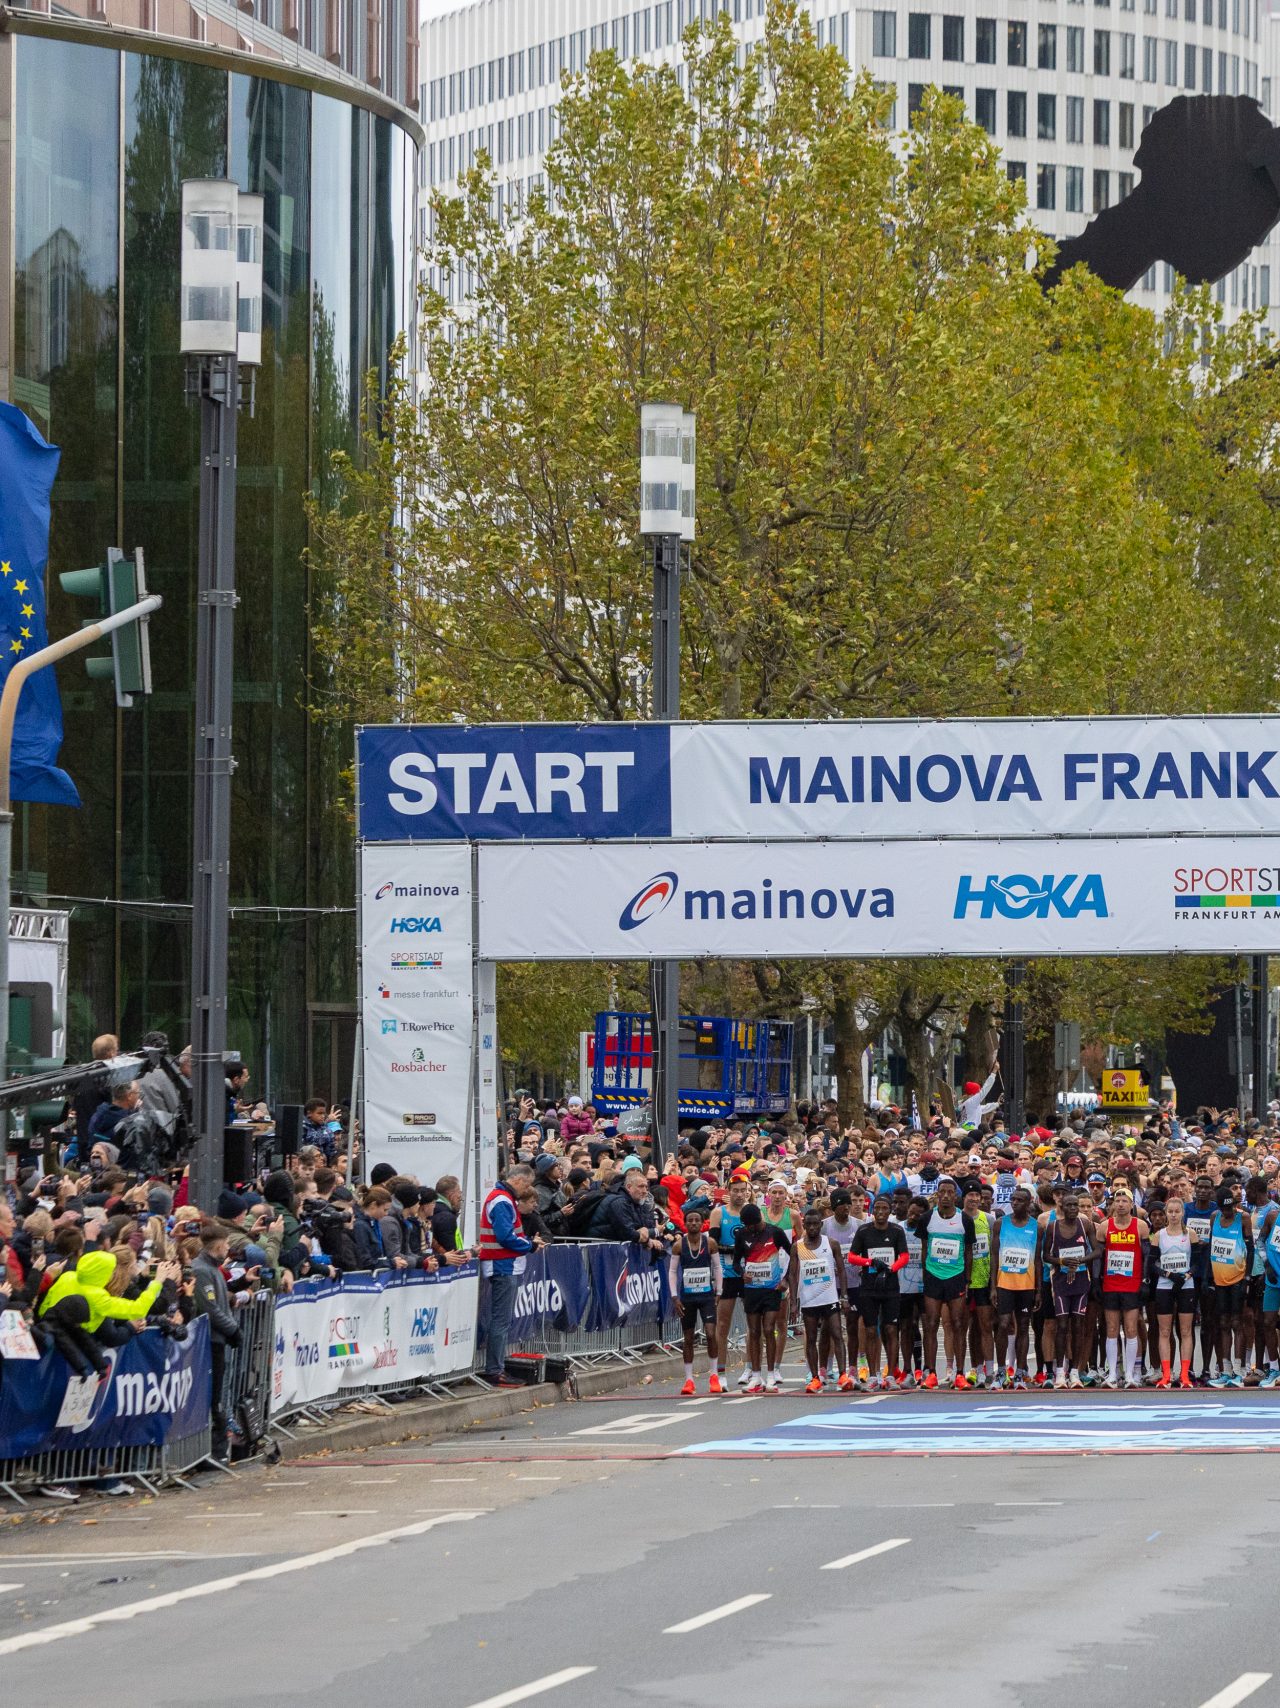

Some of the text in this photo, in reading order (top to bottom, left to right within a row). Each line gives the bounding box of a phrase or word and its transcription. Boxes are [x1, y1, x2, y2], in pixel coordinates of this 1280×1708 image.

[387, 751, 635, 816] START
[748, 753, 1042, 804] MAINOVA
[395, 884, 459, 897] mainova
[953, 873, 1108, 919] HOKA
[684, 878, 895, 920] mainova
[1174, 911, 1261, 920] FRANKFURT
[390, 917, 442, 933] HOKA
[391, 952, 443, 961] SPORTSTADT
[423, 989, 459, 998] frankfurt
[391, 1061, 448, 1073] Rosbacher
[1104, 1091, 1134, 1102] TAXI
[1213, 1245, 1226, 1254] PACE
[1004, 1256, 1019, 1264] PACE
[1110, 1260, 1123, 1268] PACE
[805, 1265, 826, 1276] PACE M
